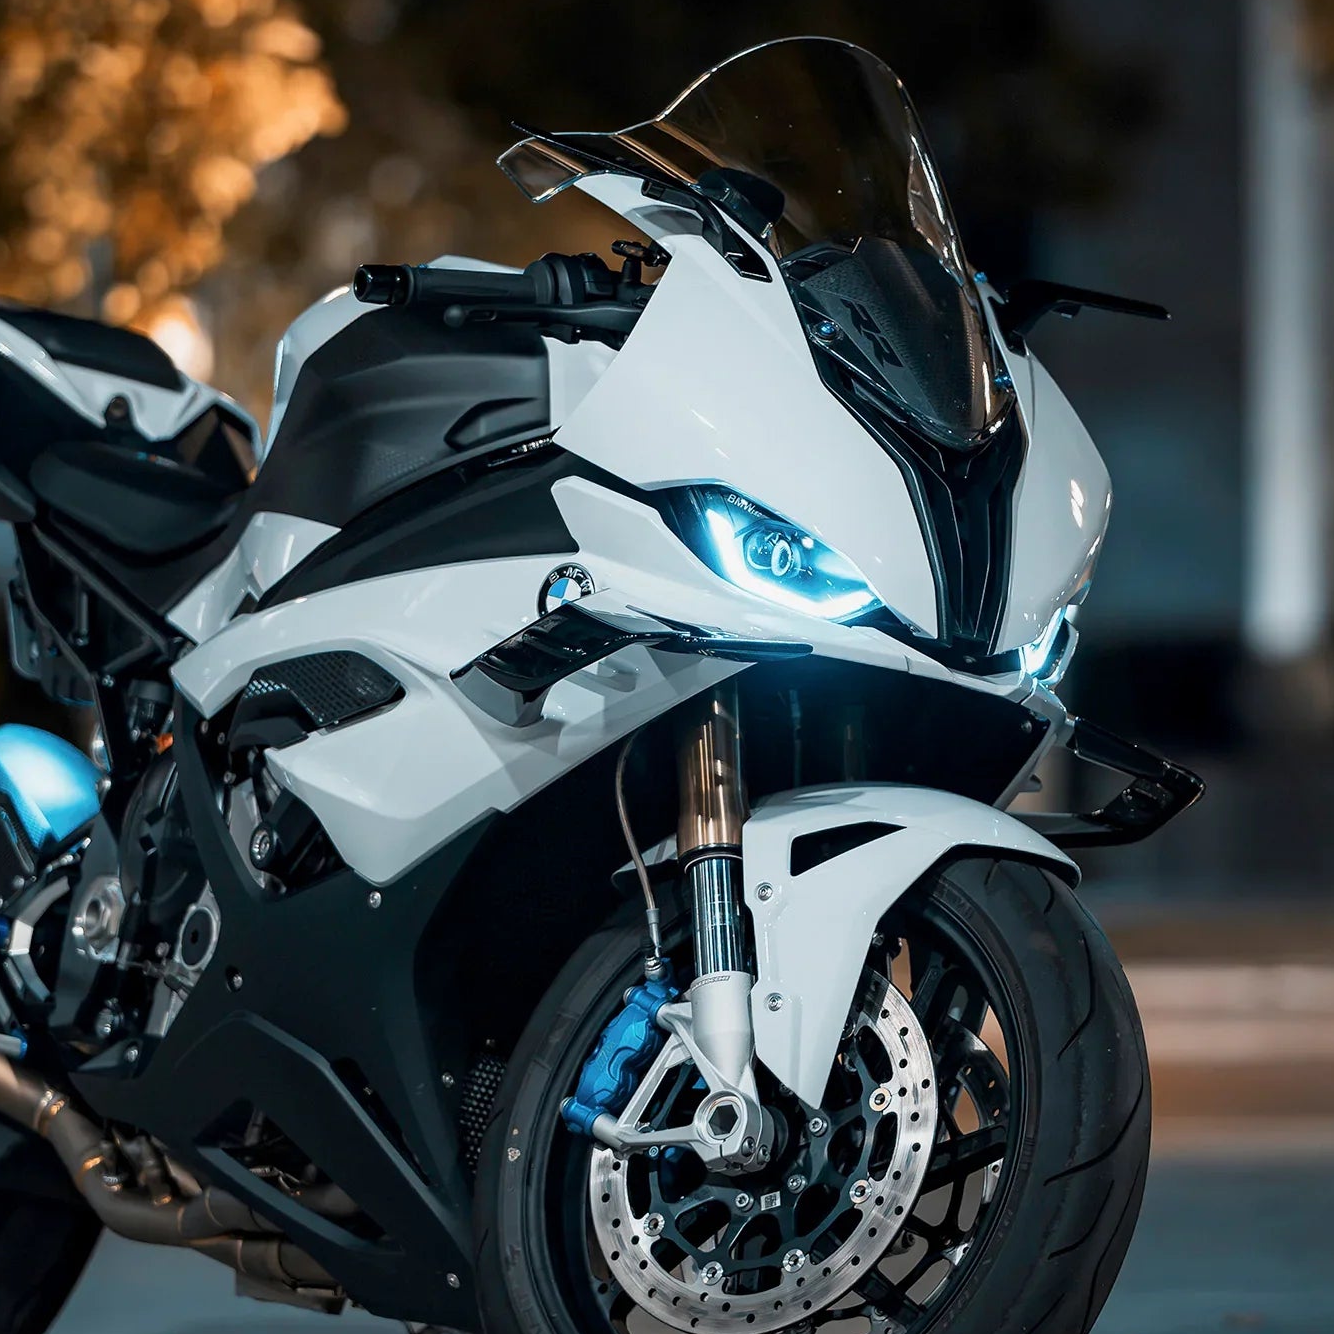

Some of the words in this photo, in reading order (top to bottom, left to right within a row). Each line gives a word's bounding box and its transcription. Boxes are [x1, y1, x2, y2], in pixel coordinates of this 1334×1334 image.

[840, 298, 904, 367] RR
[727, 493, 756, 515] BMW
[549, 566, 591, 593] BMW
